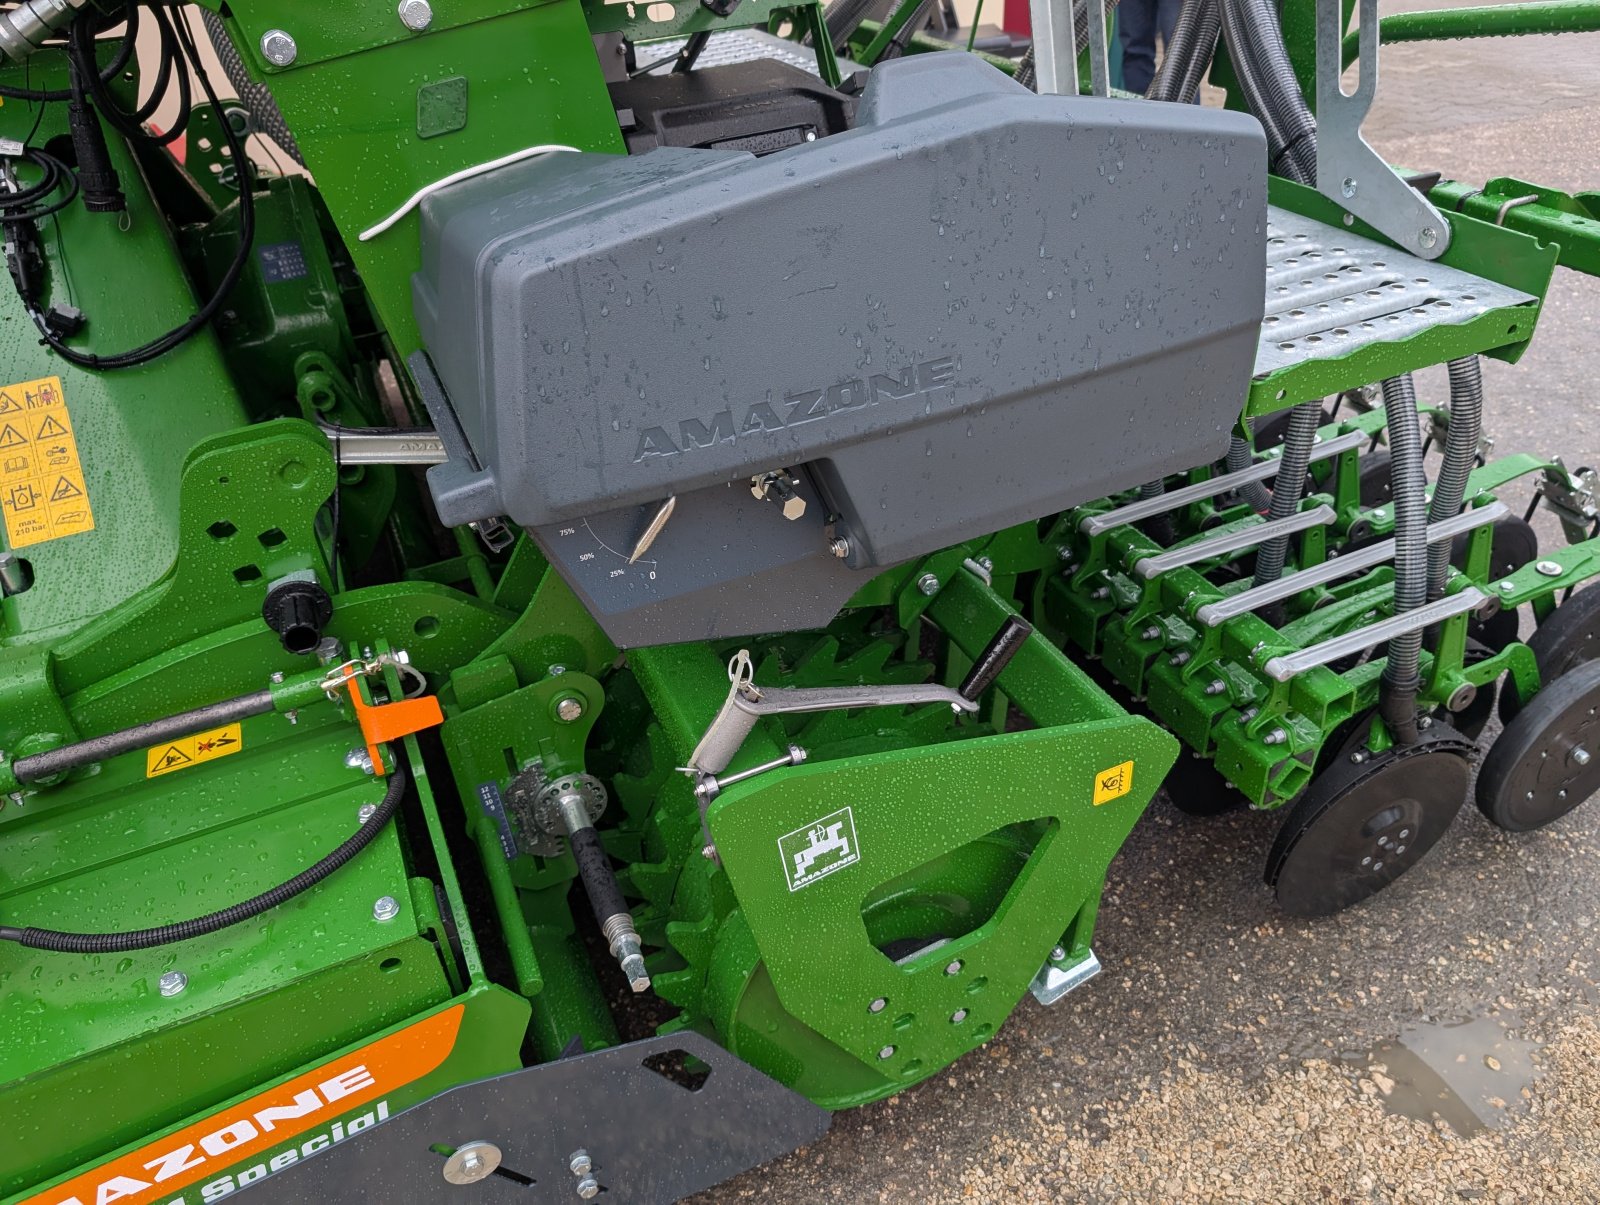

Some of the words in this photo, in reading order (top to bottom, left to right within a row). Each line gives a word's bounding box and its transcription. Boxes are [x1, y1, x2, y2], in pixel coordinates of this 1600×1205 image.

[633, 356, 954, 463] AMAZONE
[399, 441, 444, 451] AMA
[15, 527, 31, 536] 210
[32, 524, 46, 532] bar
[559, 527, 575, 537] 75%
[579, 552, 595, 562] 50%
[609, 568, 625, 578] 25%
[649, 571, 656, 580] 0
[480, 786, 489, 794] 12
[482, 792, 491, 800] 11
[793, 853, 856, 888] AMAZONE
[201, 1100, 389, 1204] Special
